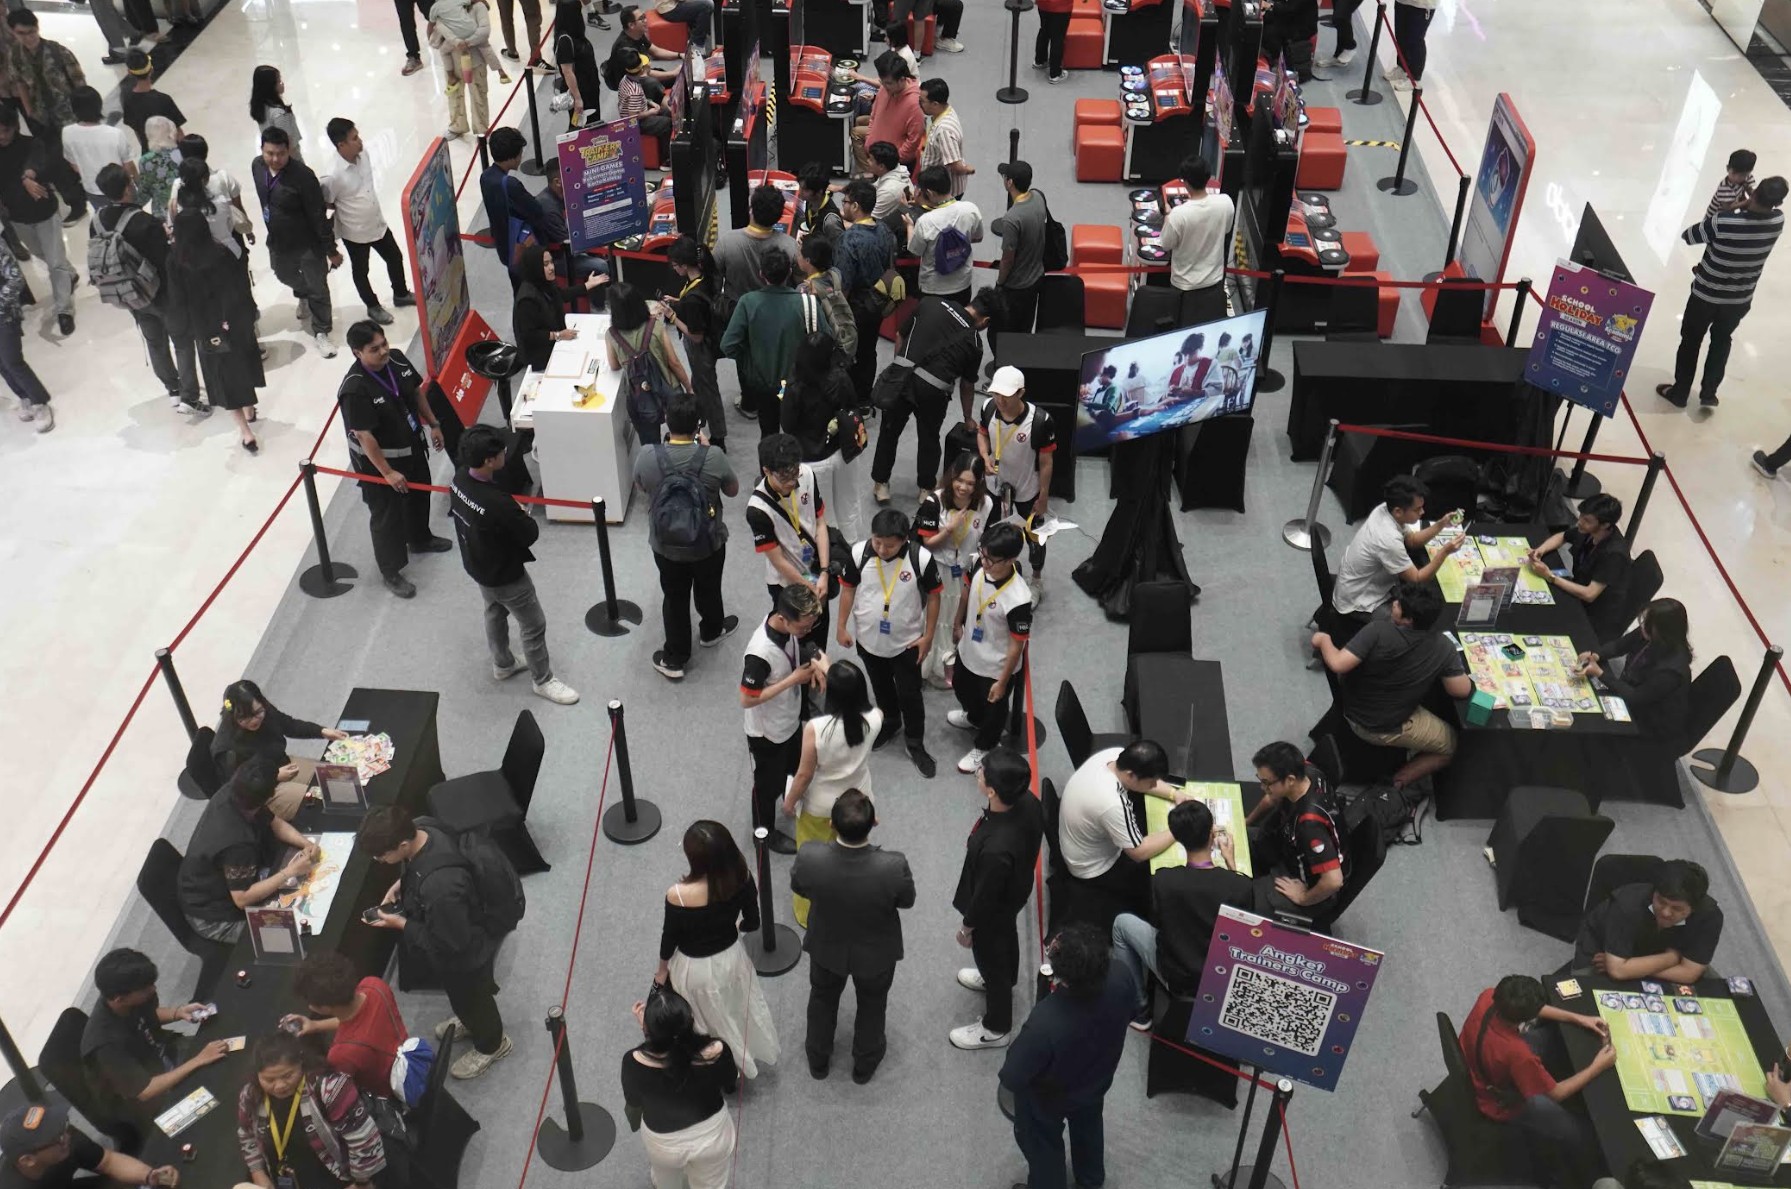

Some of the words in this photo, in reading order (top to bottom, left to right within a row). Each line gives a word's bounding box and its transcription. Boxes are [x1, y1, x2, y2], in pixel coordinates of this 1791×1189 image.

[1550, 295, 1604, 326] HOLIDAY
[1561, 294, 1596, 313] SCHOOL
[1551, 321, 1587, 339] REGULASI
[1587, 333, 1606, 347] AREA
[1607, 341, 1622, 354] TCG
[457, 490, 486, 515] EXCLUSIVE
[1230, 947, 1298, 975] Trainers
[1300, 969, 1349, 993] Camp
[1262, 946, 1325, 972] Angket
